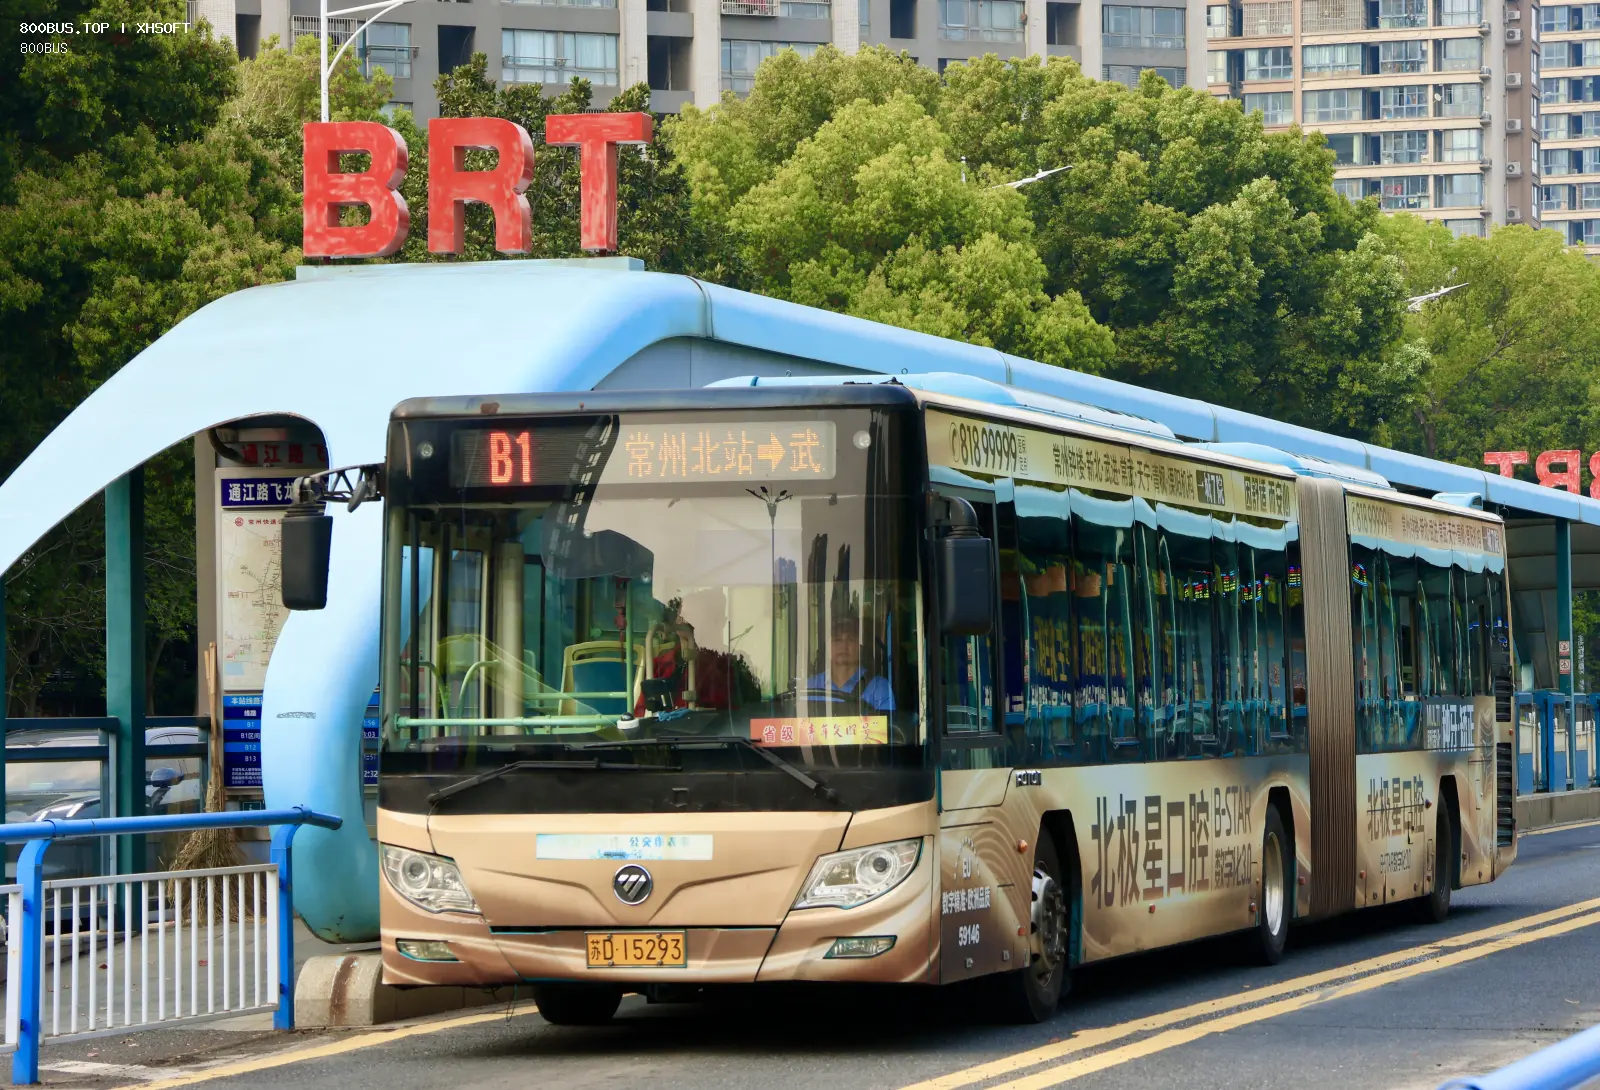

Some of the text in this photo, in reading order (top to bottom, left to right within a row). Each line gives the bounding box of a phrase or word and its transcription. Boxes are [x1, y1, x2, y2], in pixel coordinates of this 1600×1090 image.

[303, 112, 653, 258] BRT
[490, 432, 532, 483] B1
[625, 429, 824, 477] 常州北站 武
[960, 423, 1017, 472] 81899999
[231, 697, 263, 705] 本站线路
[1214, 785, 1251, 838] B-STAR
[962, 857, 971, 878] EU
[1091, 789, 1210, 909] 北极星口腔
[958, 924, 979, 946] 59146
